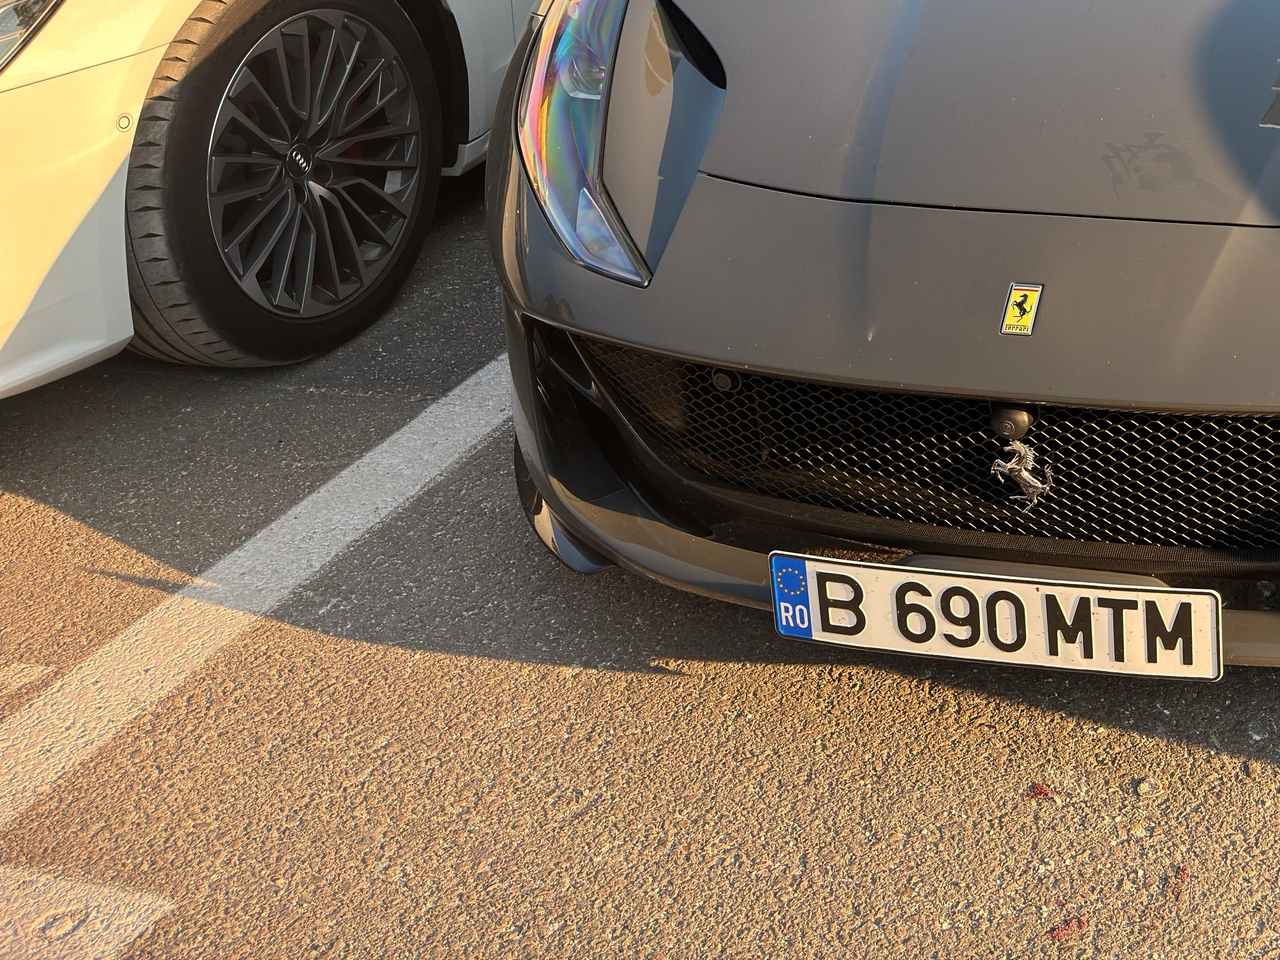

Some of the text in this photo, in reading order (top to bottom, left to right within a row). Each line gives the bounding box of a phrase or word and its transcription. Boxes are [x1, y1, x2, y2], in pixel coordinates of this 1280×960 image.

[780, 600, 809, 630] RO
[815, 570, 1194, 666] B 690 MTM
